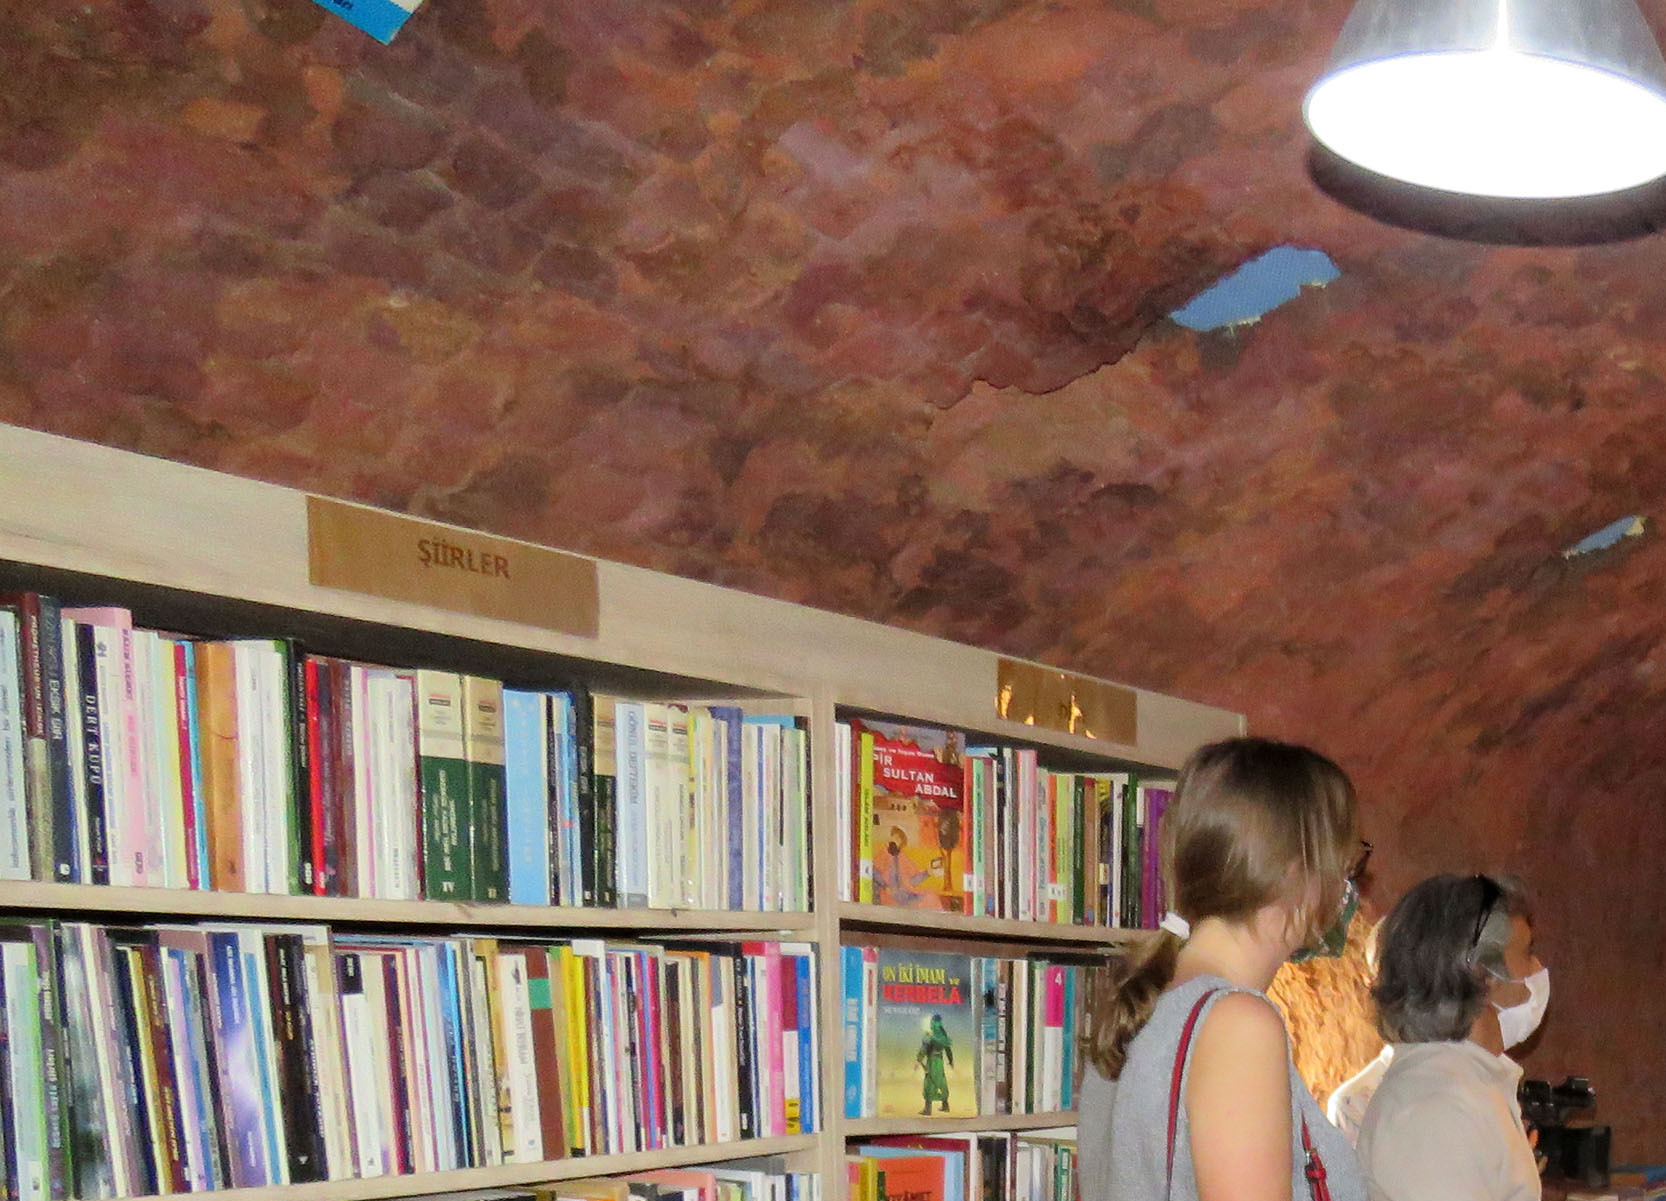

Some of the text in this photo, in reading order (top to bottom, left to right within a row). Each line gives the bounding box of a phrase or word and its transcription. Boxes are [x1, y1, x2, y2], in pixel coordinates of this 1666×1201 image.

[417, 536, 510, 579] ŞİİRLER
[85, 694, 101, 736] DERT
[883, 767, 935, 783] SULTAN
[915, 783, 958, 799] ABDAL
[1053, 971, 1063, 986] 4
